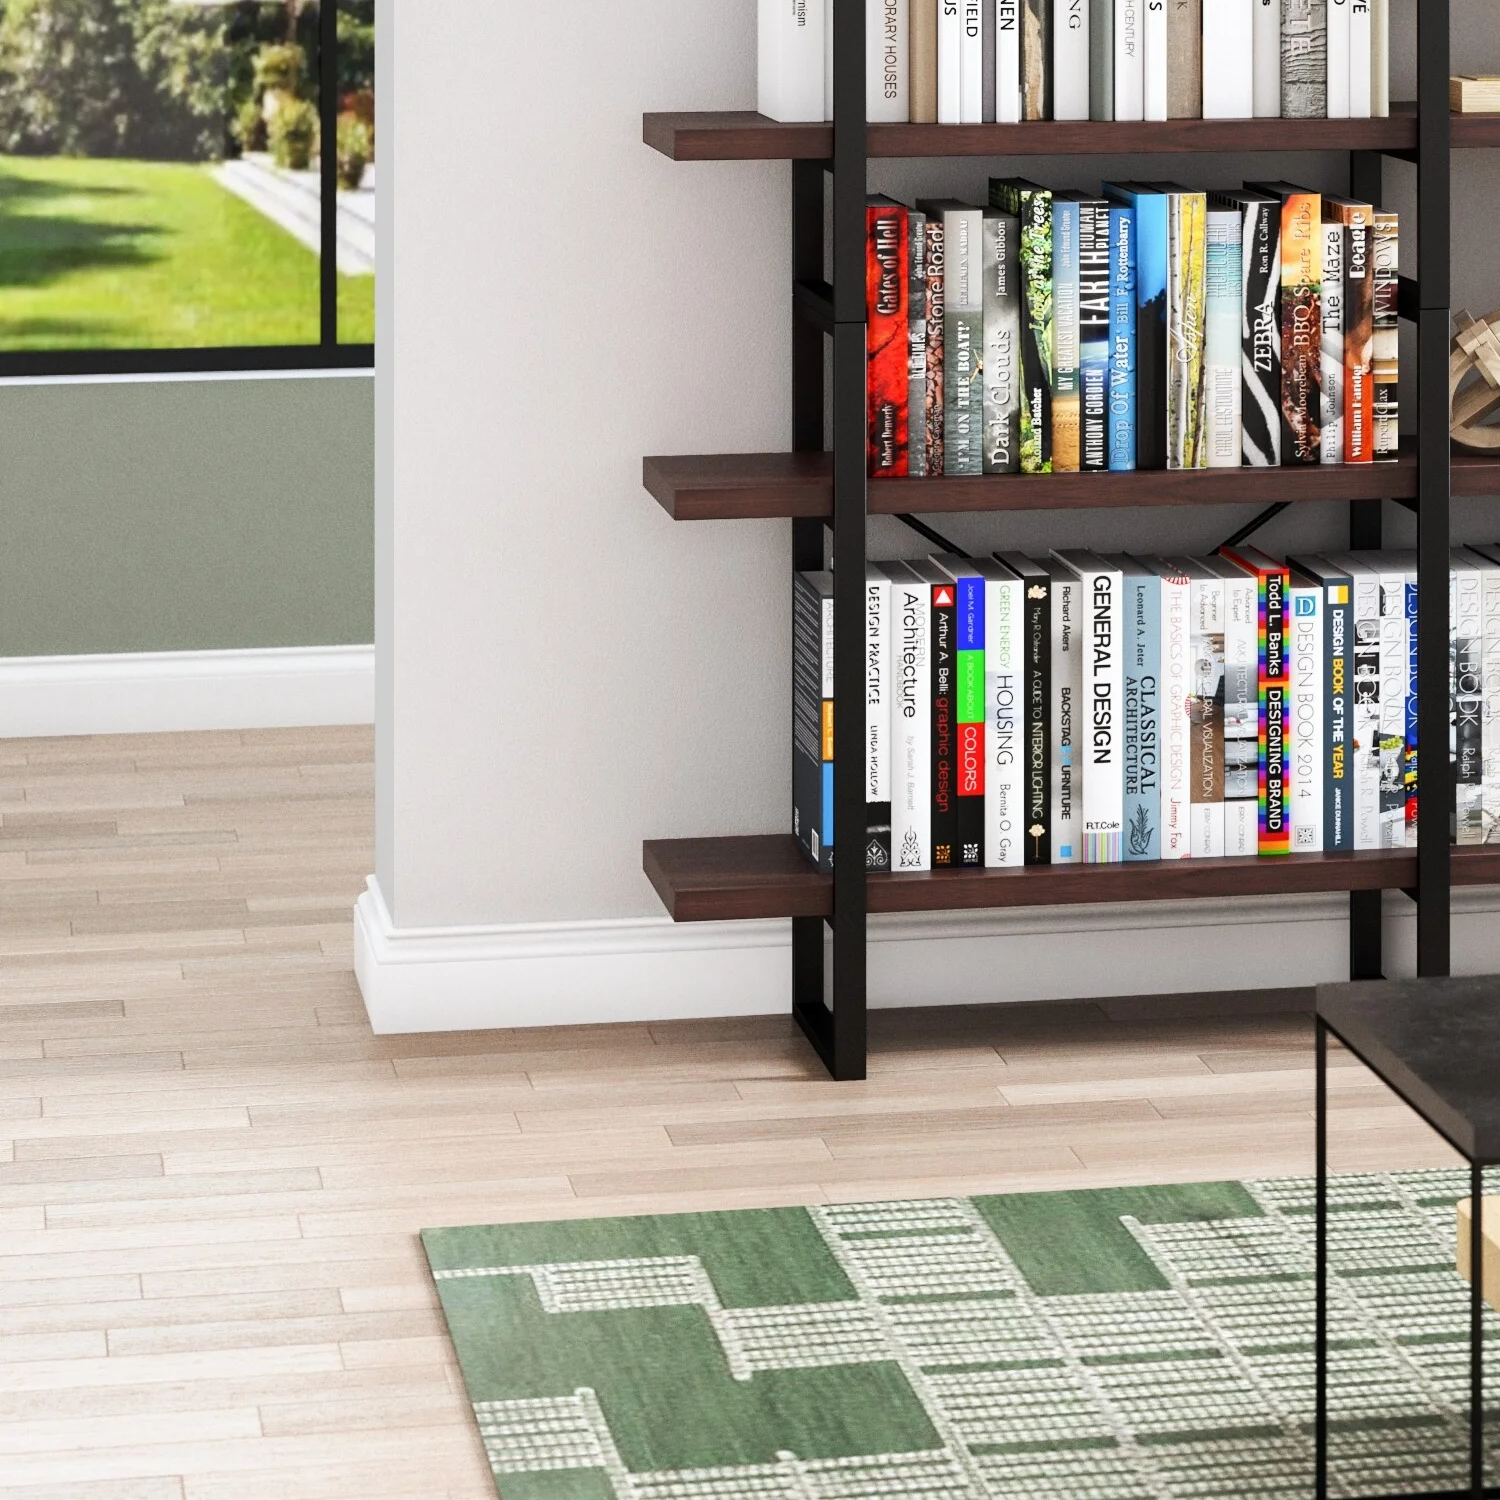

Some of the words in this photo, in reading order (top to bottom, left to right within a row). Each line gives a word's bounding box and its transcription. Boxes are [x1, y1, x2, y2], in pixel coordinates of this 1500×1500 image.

[1124, 8, 1135, 58] CENTURY
[884, 45, 898, 99] HOUSES
[876, 220, 899, 250] Hell
[995, 221, 1006, 261] Gibbon
[1259, 207, 1271, 242] Callway
[1292, 202, 1312, 241] Ribs
[1348, 211, 1368, 279] Beagle
[876, 252, 899, 270] of
[927, 229, 944, 277] Road
[1259, 255, 1270, 274] Ron
[1292, 248, 1315, 297] Spare
[1322, 231, 1341, 283] Maze
[876, 273, 899, 315] Gates
[995, 263, 1008, 297] James
[927, 281, 944, 336] Stone
[1058, 282, 1073, 328] VACATION
[1170, 293, 1204, 363] Aspen
[1293, 300, 1315, 347] BBQ
[1322, 295, 1340, 335] The
[1058, 330, 1073, 374] GREATEST
[1254, 299, 1274, 373] ZEBRA
[990, 329, 1011, 406] Clouds
[1058, 376, 1073, 390] MY
[1109, 335, 1129, 388] Water
[1085, 368, 1104, 416] GORDIEN
[1325, 372, 1336, 416] Johnson
[990, 411, 1011, 465] Dark
[1085, 418, 1105, 466] ANTHONY
[1325, 420, 1338, 459] Philip
[868, 586, 881, 638] DESIGN
[1062, 585, 1072, 622] Richard
[1136, 584, 1147, 626] Leonard
[1268, 575, 1282, 610] Todd
[938, 611, 949, 649] Arthur
[1062, 623, 1072, 652] Akers
[1092, 575, 1112, 677] GENERAL
[1268, 613, 1282, 628] L.
[1332, 609, 1345, 657] DESIGN
[868, 642, 881, 705] PRACTICE
[902, 591, 920, 718] Architecture
[1136, 642, 1147, 668] Jeter
[1268, 632, 1282, 676] Banks
[1297, 621, 1315, 688] DESIGN
[1332, 658, 1345, 695] BOOK
[938, 667, 949, 695] Belli:
[936, 697, 952, 755] graphic
[996, 674, 1014, 765] HOUSING
[1092, 682, 1112, 765] DESIGN
[1297, 693, 1315, 749] BOOK
[1332, 697, 1345, 716] OF
[1332, 716, 1345, 743] THE
[1125, 675, 1138, 796] ARCHITECTURE
[1139, 675, 1157, 796] CLASSICAL
[1268, 690, 1282, 776] DESIGNING
[963, 726, 978, 792] COLORS
[1297, 753, 1315, 800] 2014
[1332, 744, 1345, 780] YEAR
[936, 759, 952, 813] design
[1268, 778, 1282, 831] BRAND
